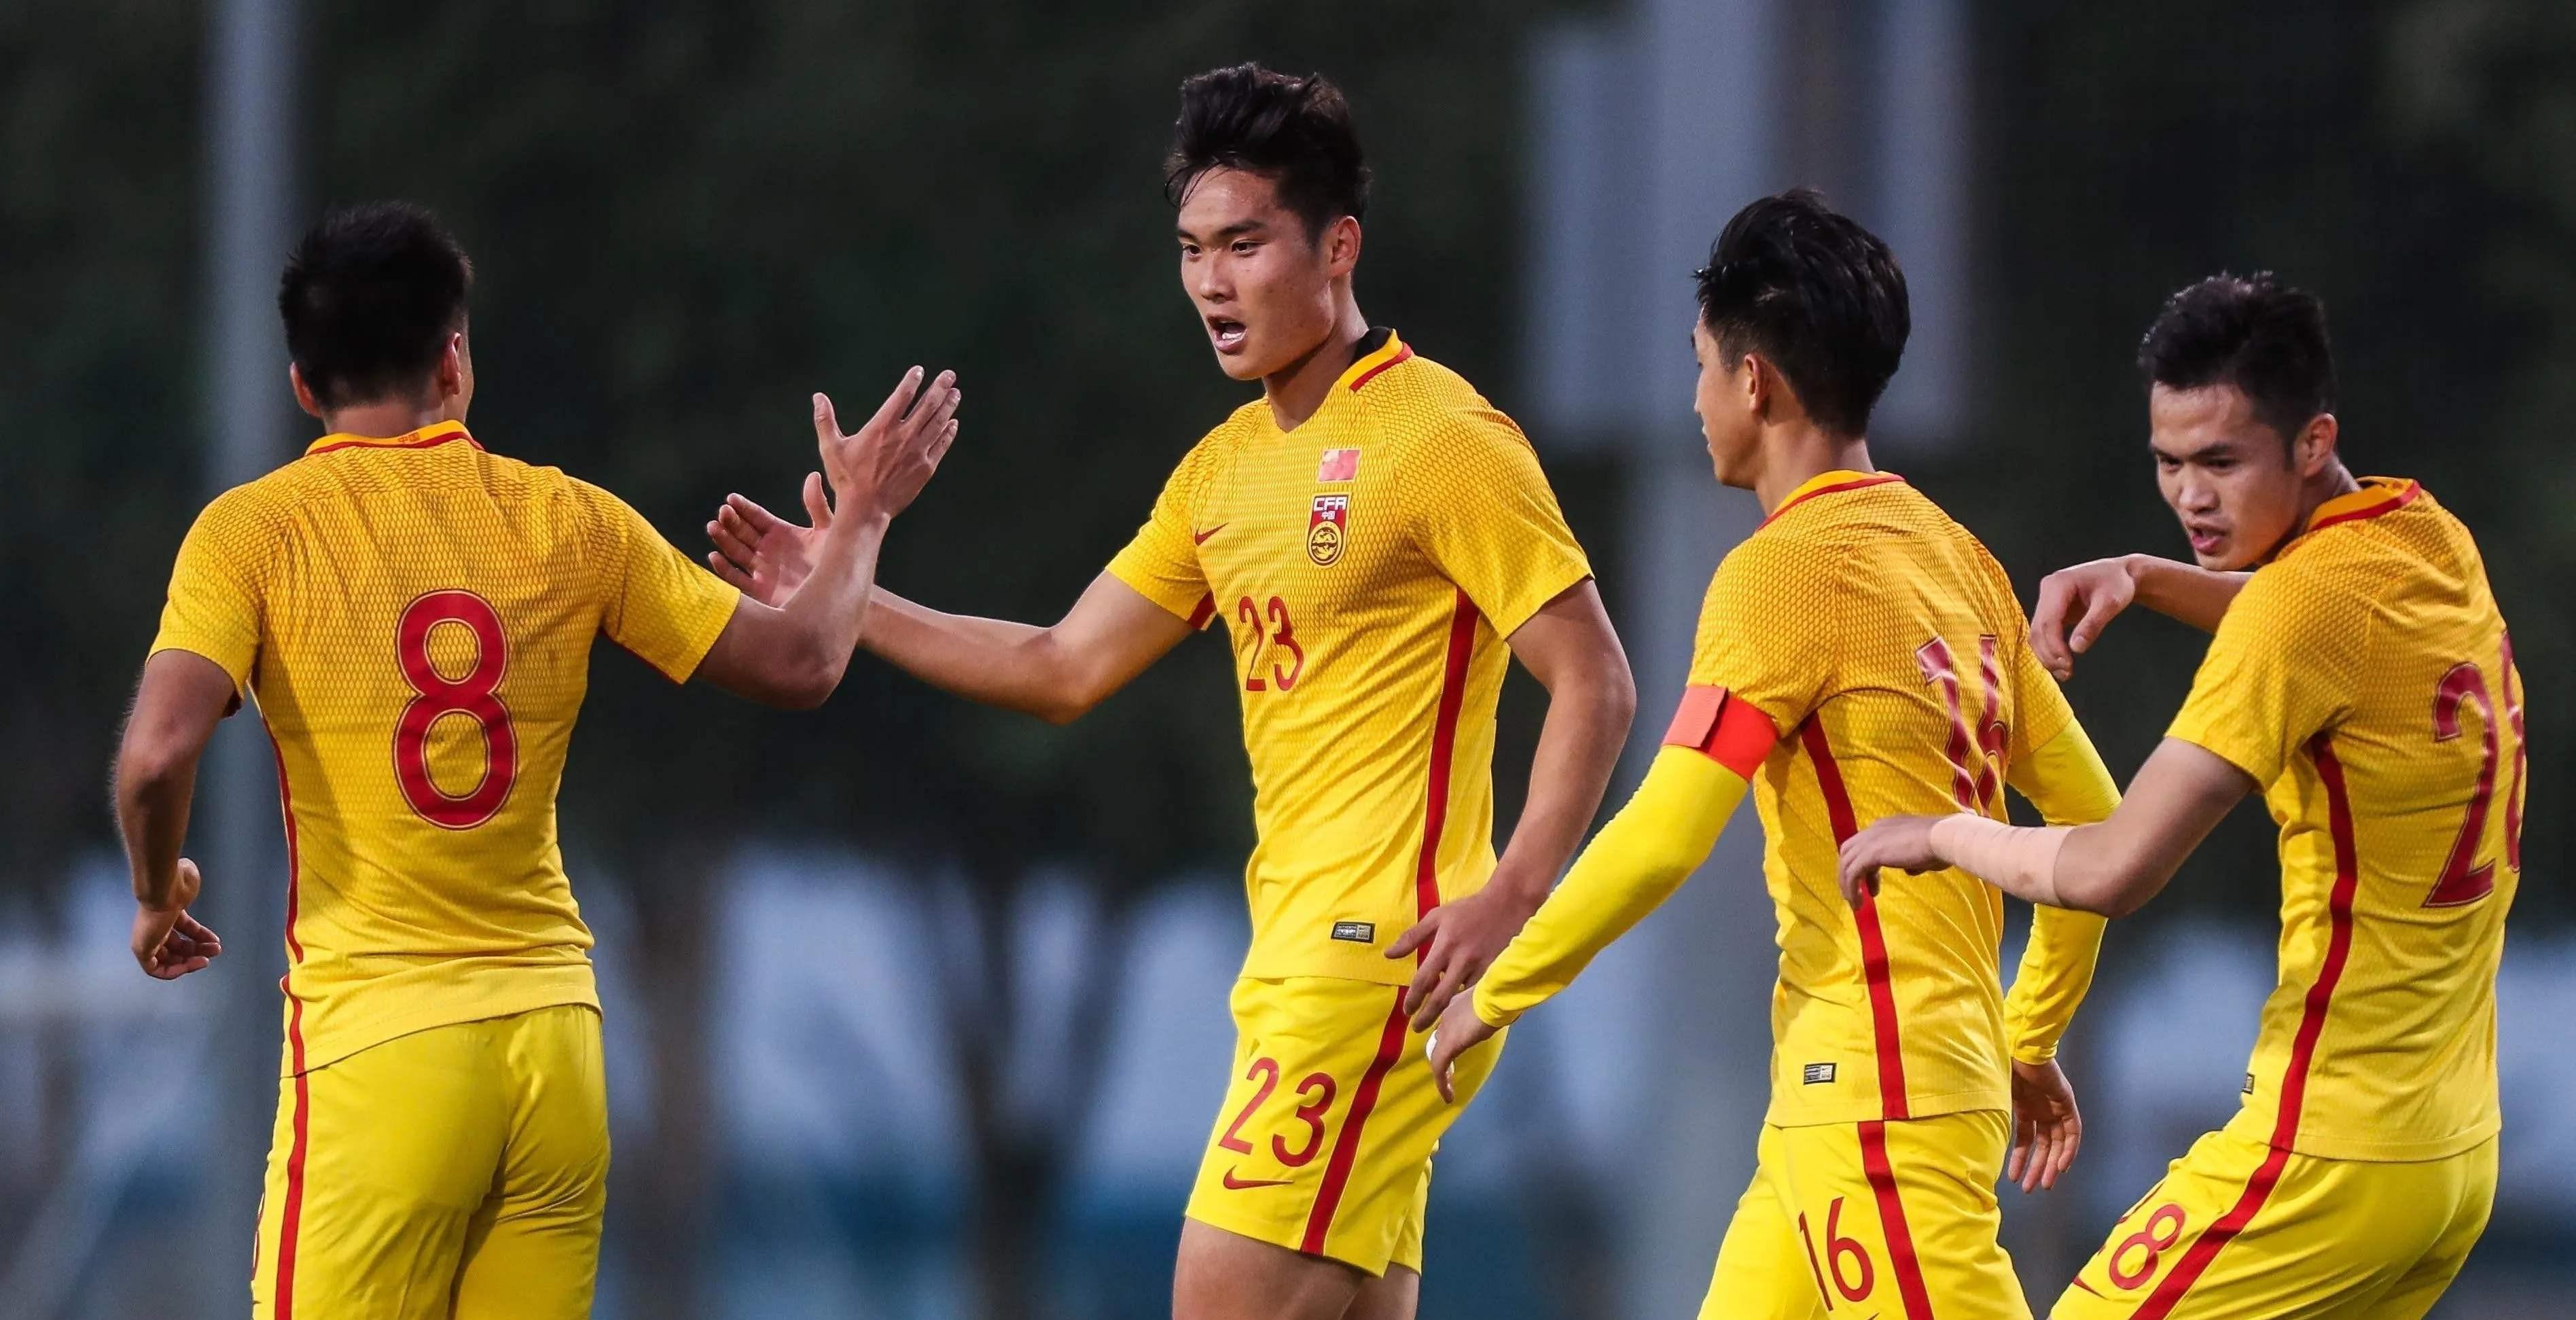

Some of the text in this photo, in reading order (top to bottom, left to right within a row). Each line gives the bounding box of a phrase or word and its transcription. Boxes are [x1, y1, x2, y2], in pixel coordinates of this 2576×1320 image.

[1313, 497, 1348, 512] CFA
[1238, 596, 1304, 692] 23
[391, 588, 518, 831] 8
[1218, 1057, 1337, 1167] 23
[1798, 1196, 1874, 1312] 16
[2098, 1185, 2186, 1290] 8
